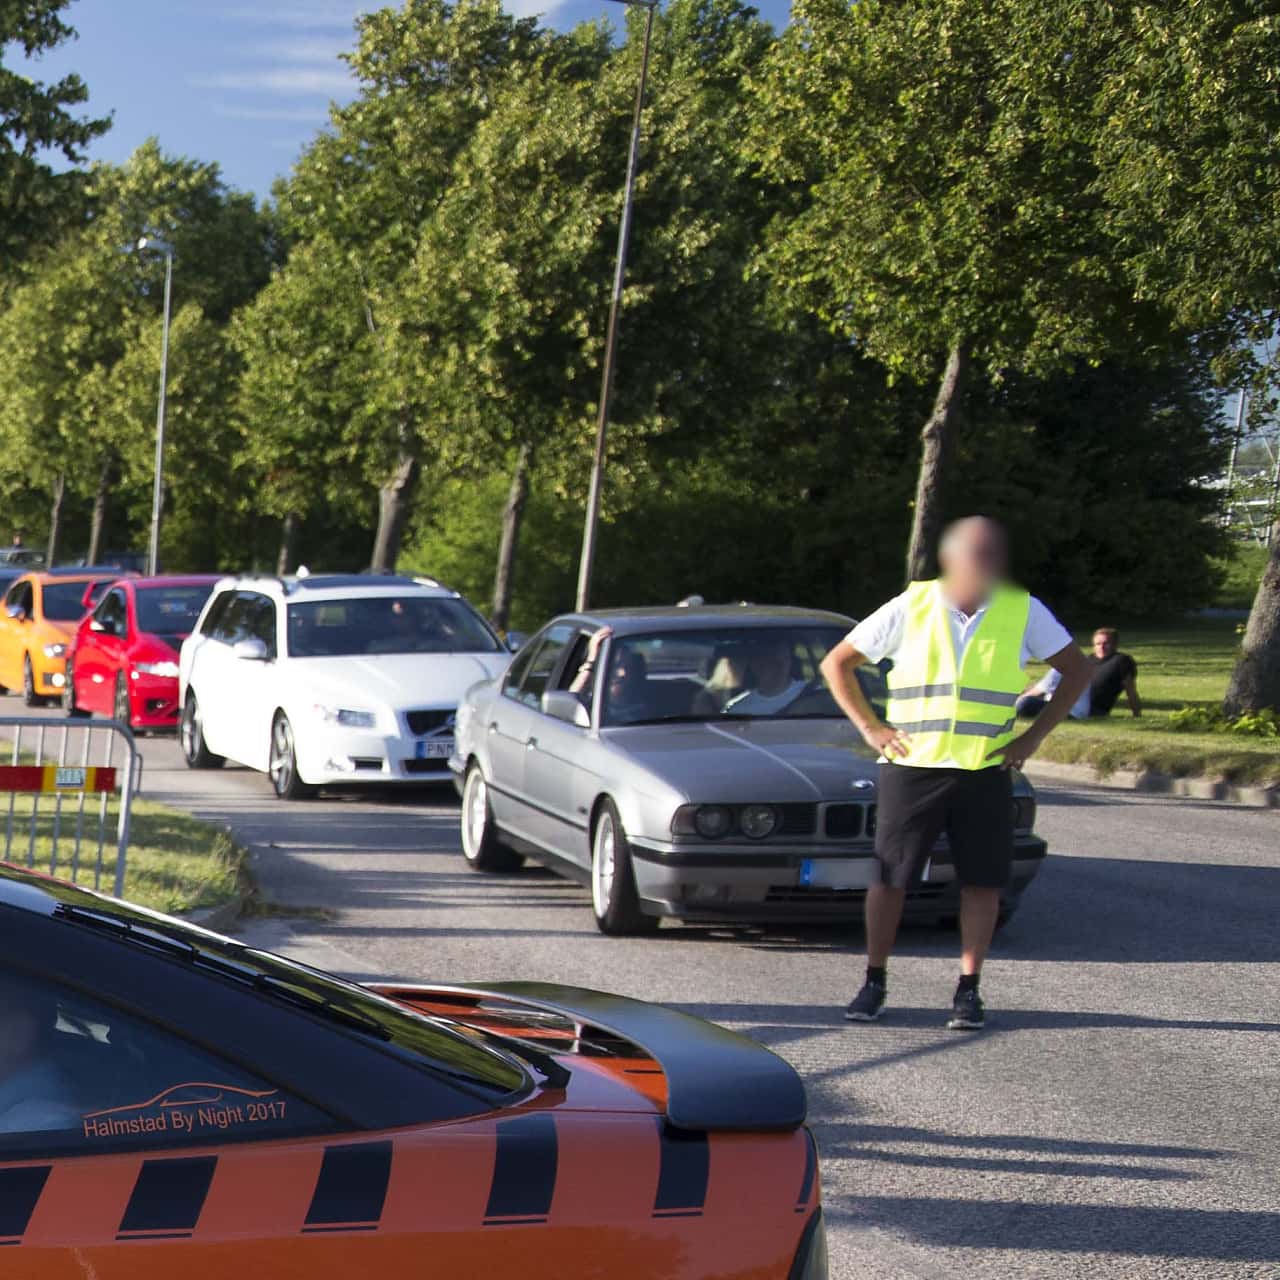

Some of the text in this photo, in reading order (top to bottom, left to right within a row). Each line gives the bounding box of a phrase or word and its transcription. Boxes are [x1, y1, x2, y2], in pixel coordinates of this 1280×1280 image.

[83, 1102, 286, 1137] Halmstad By Night 2017
